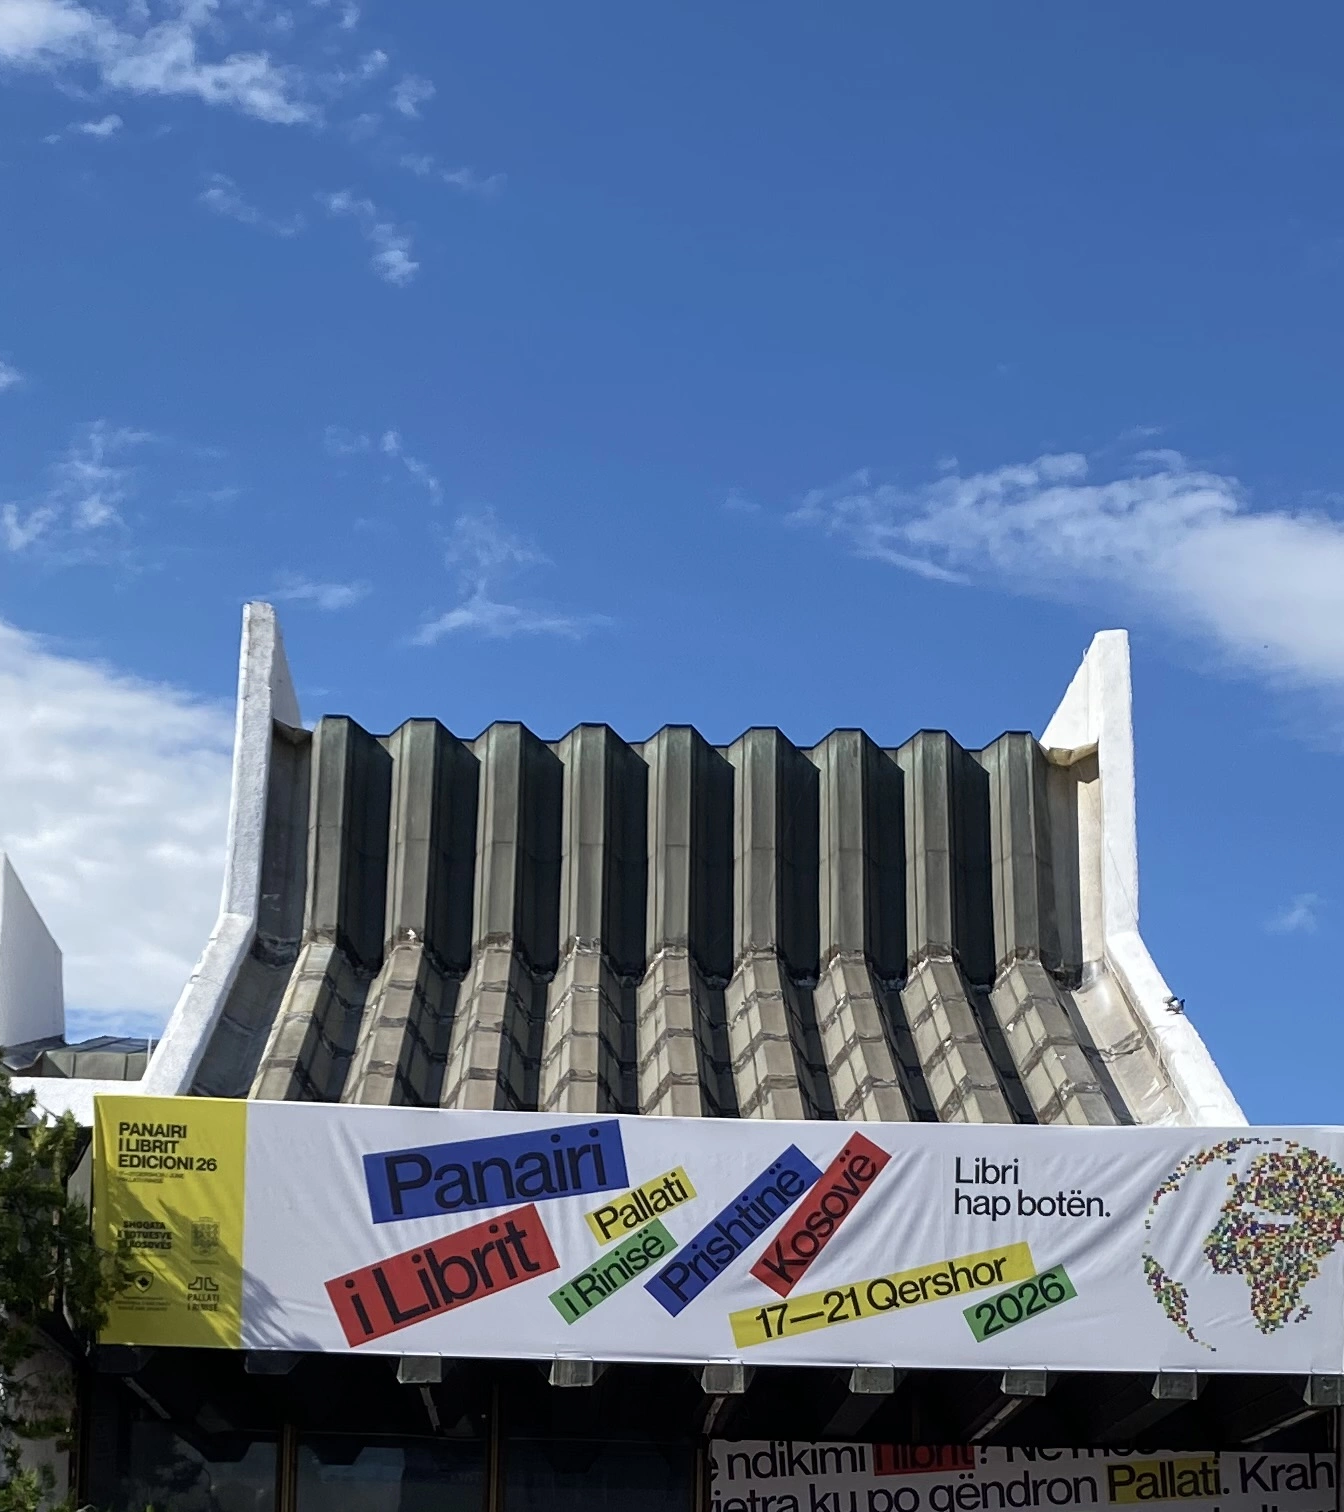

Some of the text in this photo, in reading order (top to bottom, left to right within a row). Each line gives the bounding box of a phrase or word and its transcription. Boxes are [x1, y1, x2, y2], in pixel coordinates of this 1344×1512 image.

[119, 1121, 188, 1139] PANAIRI
[119, 1139, 180, 1154] I LIBRIT
[118, 1154, 218, 1172] EDICIONI 26
[383, 1126, 607, 1216] Panairi
[954, 1157, 1020, 1186] Libri
[123, 1220, 166, 1230] SHOQATA
[594, 1172, 690, 1240] Pallati
[762, 1150, 876, 1284] Kosovë
[954, 1188, 1112, 1220] hap botën.
[660, 1164, 806, 1303] Prishtinë
[344, 1220, 541, 1336] i Librit
[559, 1229, 666, 1317] i Rinisë
[866, 1254, 1009, 1311] Qershor
[974, 1272, 1067, 1336] 2026
[727, 1441, 866, 1481] ndikimi
[1106, 1459, 1230, 1502] Pallati.
